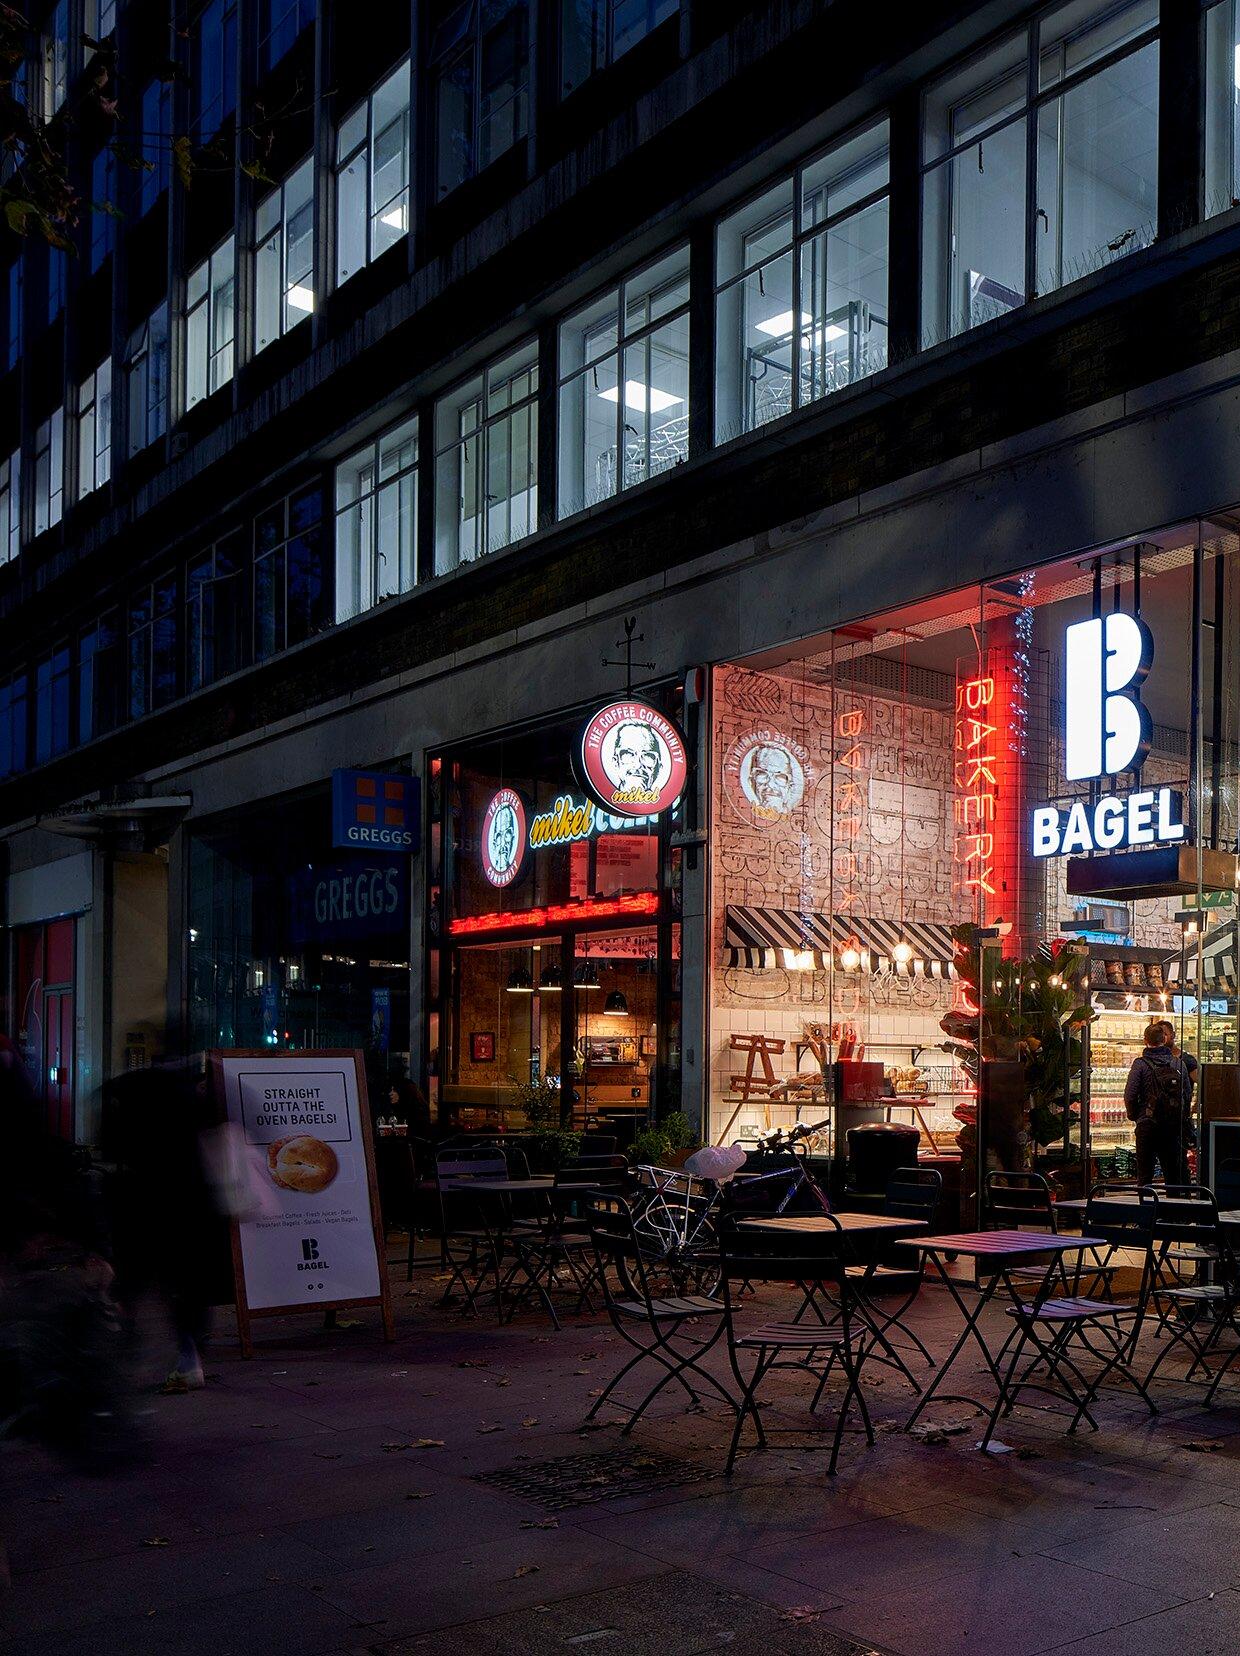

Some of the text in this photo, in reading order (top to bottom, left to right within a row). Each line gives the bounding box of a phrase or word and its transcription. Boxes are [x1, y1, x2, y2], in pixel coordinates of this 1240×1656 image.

[1065, 612, 1144, 782] B
[589, 706, 684, 764] THE COFFEE COMMUNITY
[611, 786, 661, 804] mikel
[964, 678, 998, 895] BAKERY
[531, 795, 594, 849] mikel
[1032, 788, 1184, 857] BAGEL
[347, 826, 413, 845] GREGGS
[314, 867, 399, 924] GREGGS
[264, 1088, 321, 1099] STRAIGHT
[262, 1101, 325, 1112] OUTTA THE
[256, 1113, 337, 1126] OVEN BAGELS!
[281, 1220, 301, 1228] Bagels
[301, 1238, 320, 1260] B
[296, 1261, 330, 1271] BAGEL
